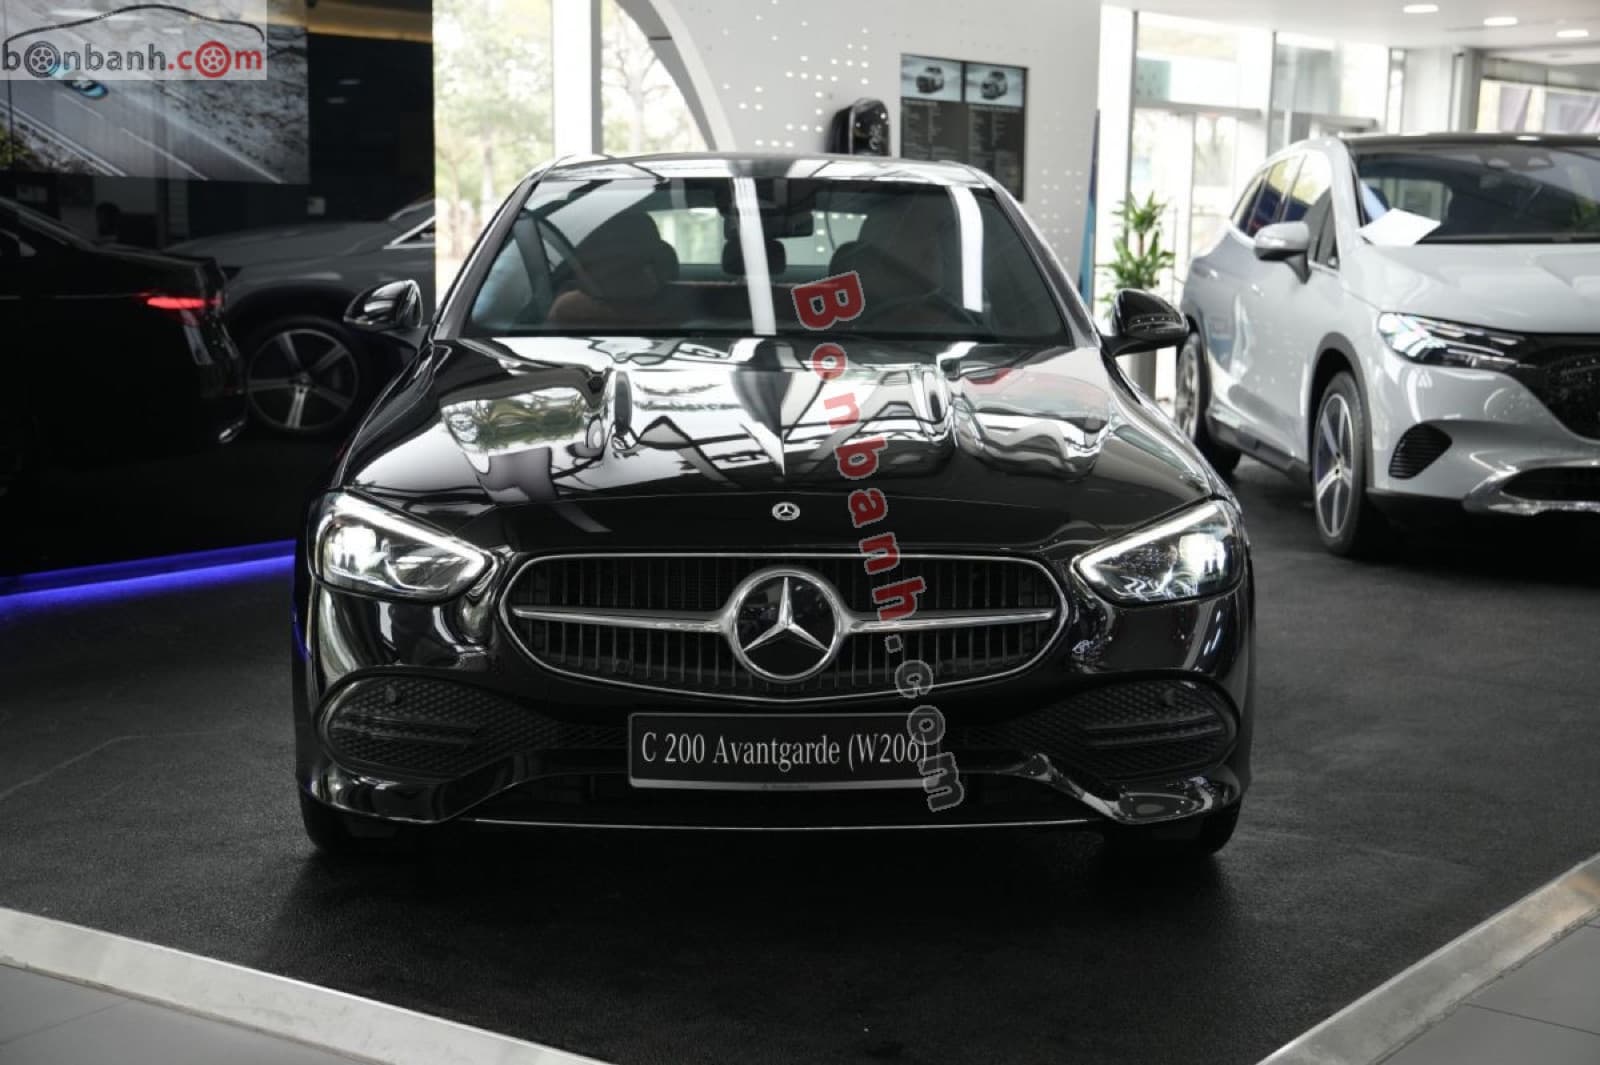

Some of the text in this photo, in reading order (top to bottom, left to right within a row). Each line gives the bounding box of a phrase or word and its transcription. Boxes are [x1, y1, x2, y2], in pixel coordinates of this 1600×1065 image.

[642, 732, 928, 772] C 200 Avantgarde (W206)
